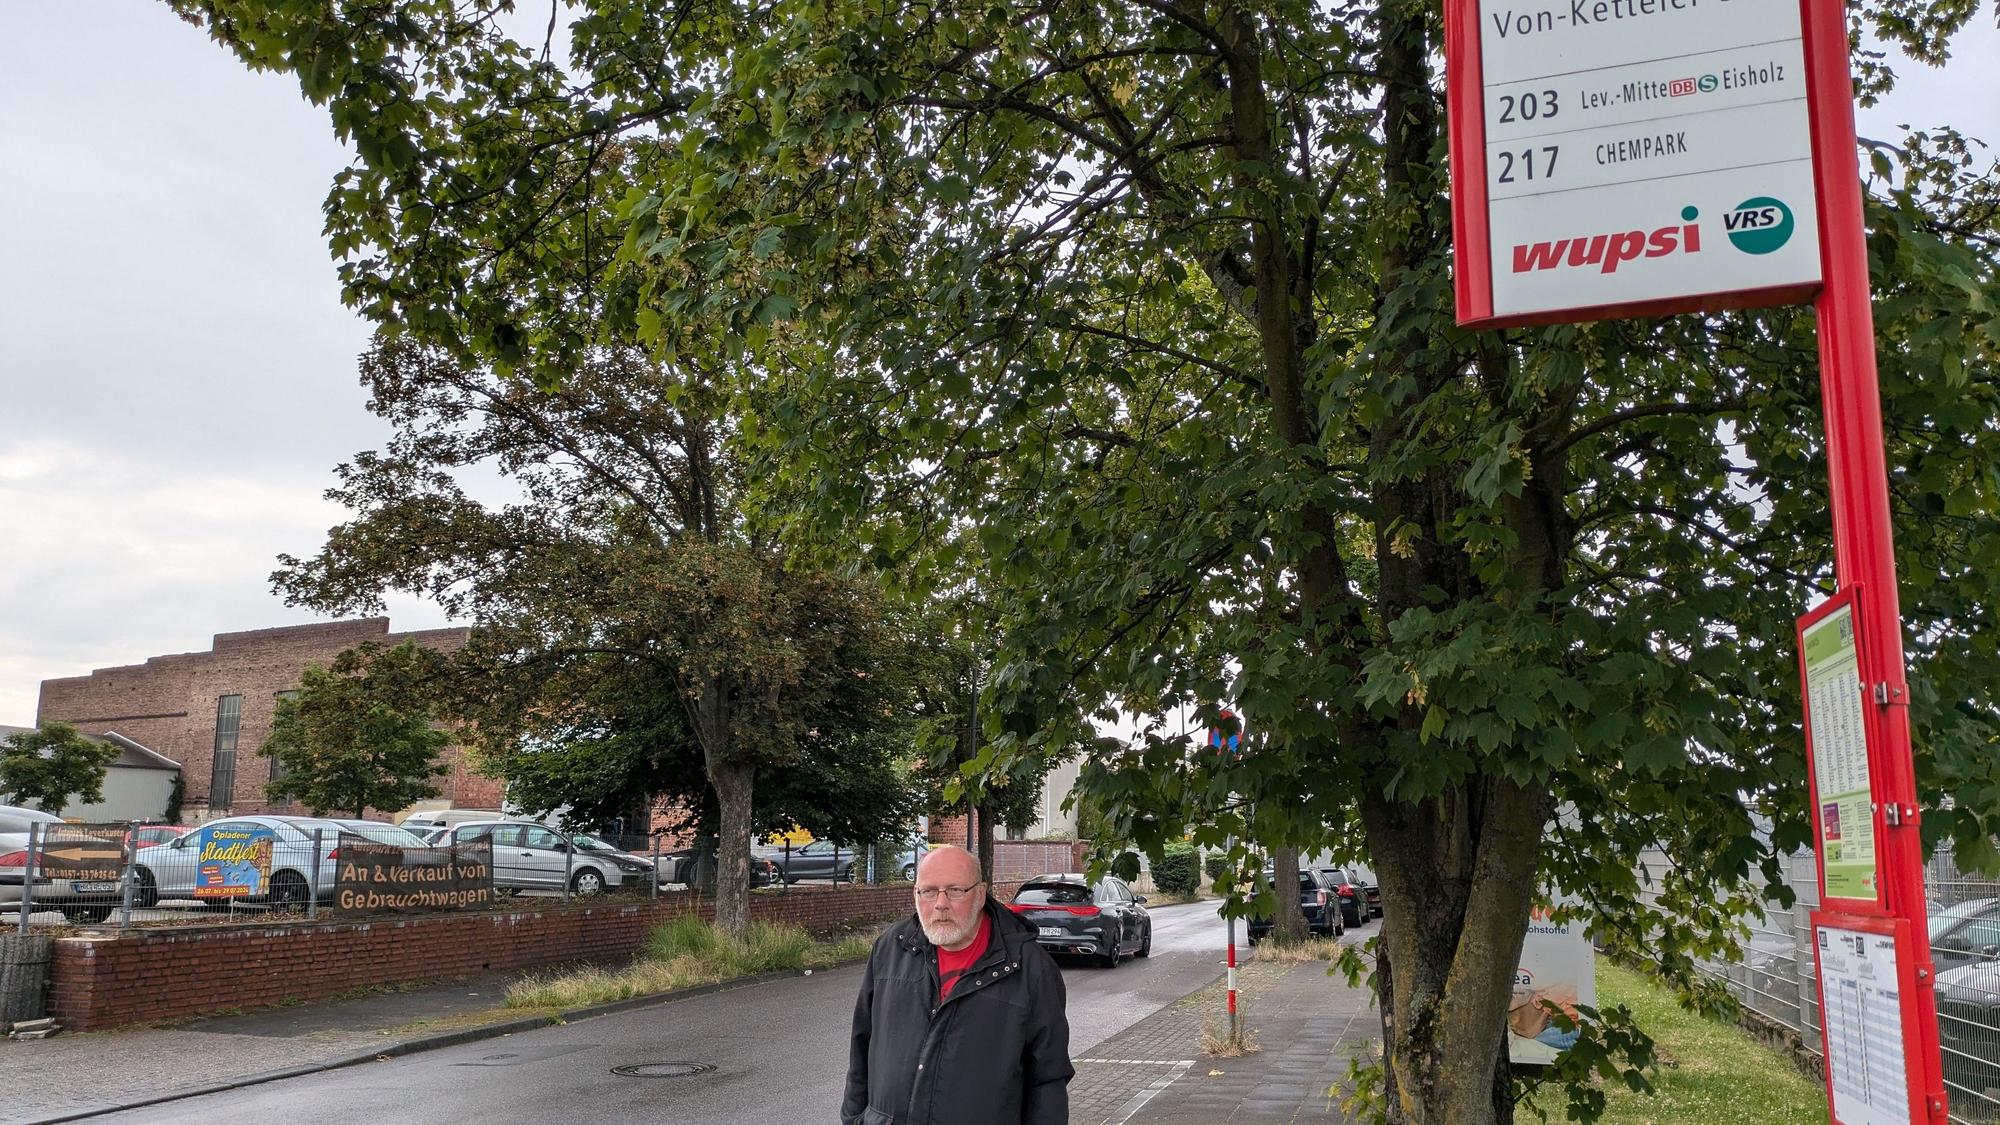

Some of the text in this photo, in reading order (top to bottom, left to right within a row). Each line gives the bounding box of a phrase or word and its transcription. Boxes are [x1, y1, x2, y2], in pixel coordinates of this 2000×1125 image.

[1499, 62, 1785, 124] 203 Lev.-Mitte DB S Eisholz
[1498, 131, 1688, 184] 217 CHEMPARK
[1723, 207, 1775, 231] VRS
[1512, 205, 1701, 274] wupsi
[213, 830, 252, 840] Opladener
[200, 842, 260, 865] Stadtfest
[342, 863, 486, 883] An & Verkauf von
[341, 889, 488, 910] Gebrauchtwagen
[1527, 926, 1570, 935] ohstoffe!
